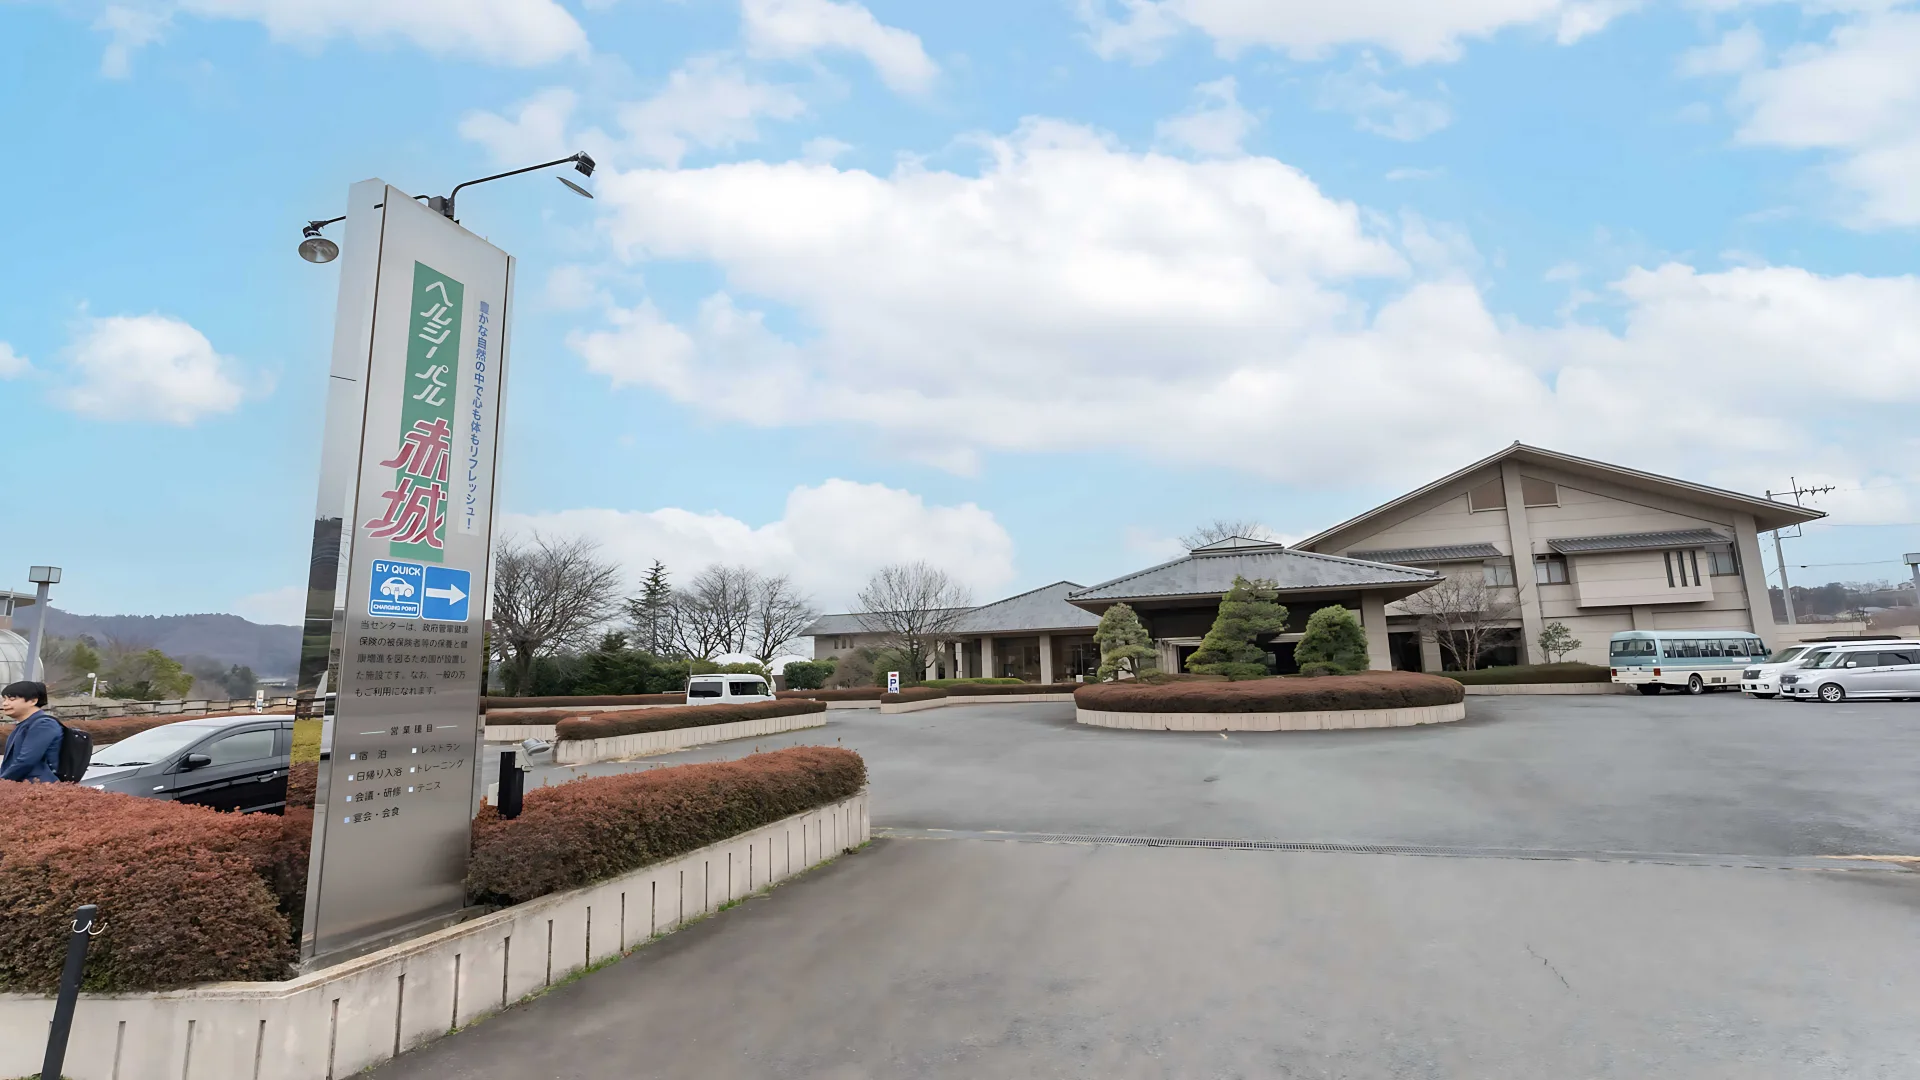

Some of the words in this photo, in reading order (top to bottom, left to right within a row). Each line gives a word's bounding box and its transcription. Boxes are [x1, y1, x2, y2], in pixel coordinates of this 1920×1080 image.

[361, 417, 453, 549] 赤城
[375, 563, 390, 573] EV
[391, 565, 421, 577] QUICK
[373, 603, 401, 612] CHARGING
[401, 604, 417, 613] POINT
[889, 678, 897, 687] P
[421, 743, 461, 754] レストラン
[417, 758, 465, 773] トレーニング
[356, 767, 402, 782] 日帰り入浴
[417, 781, 441, 793] テニス
